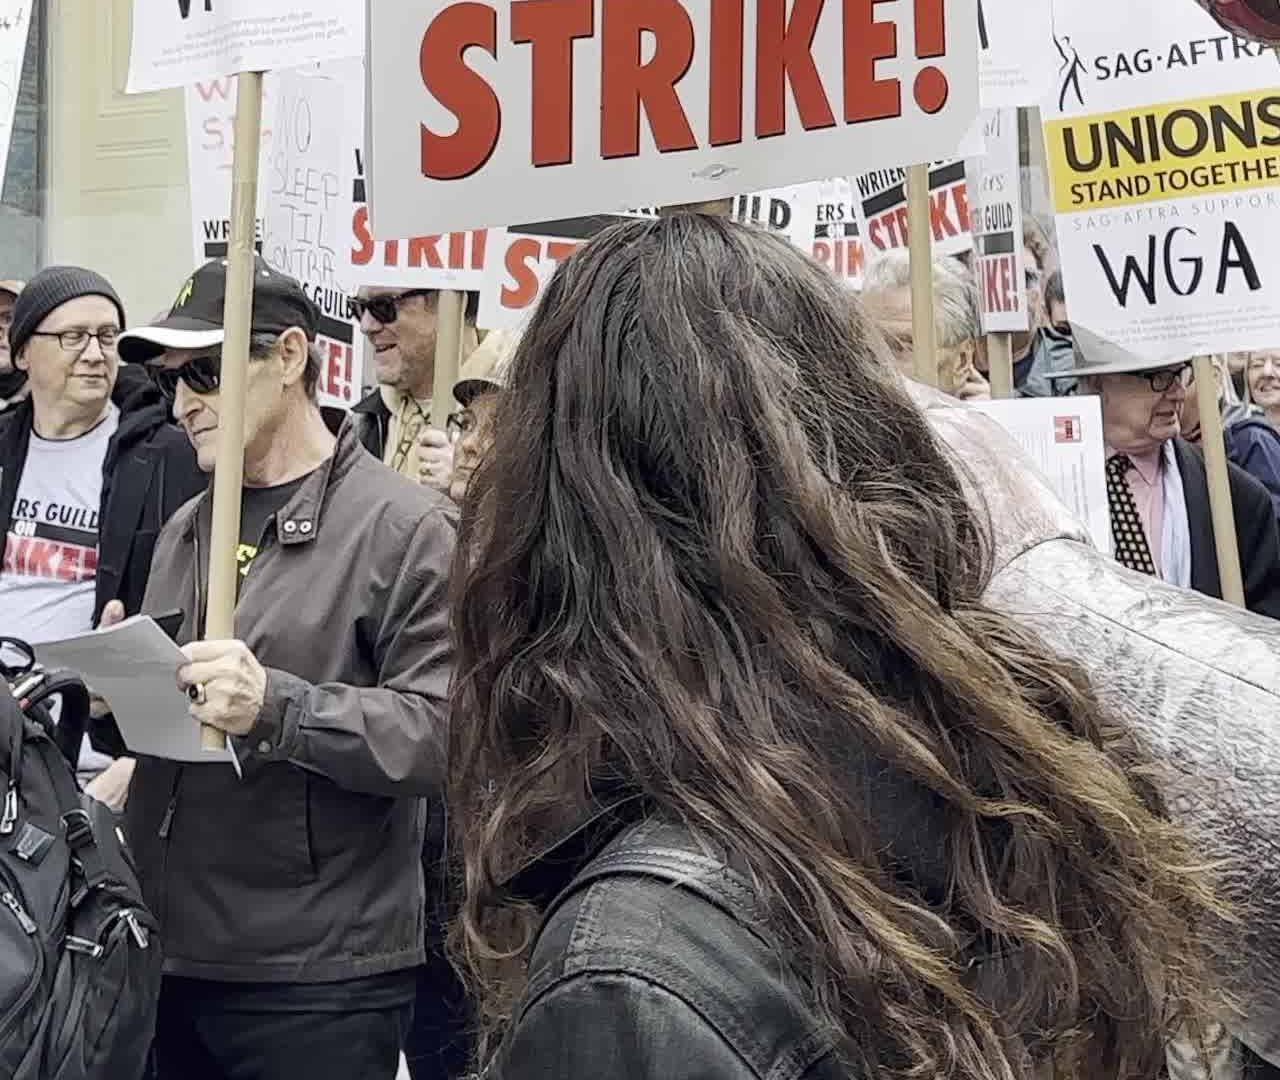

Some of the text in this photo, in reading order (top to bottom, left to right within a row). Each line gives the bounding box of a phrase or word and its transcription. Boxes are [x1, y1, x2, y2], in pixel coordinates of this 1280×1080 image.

[857, 162, 906, 198] WRITER
[1071, 175, 1150, 205] STAND
[869, 184, 969, 252] STRKE
[984, 202, 1013, 232] GUILD
[980, 255, 1019, 314] IKE!
[1092, 220, 1263, 308] WGA
